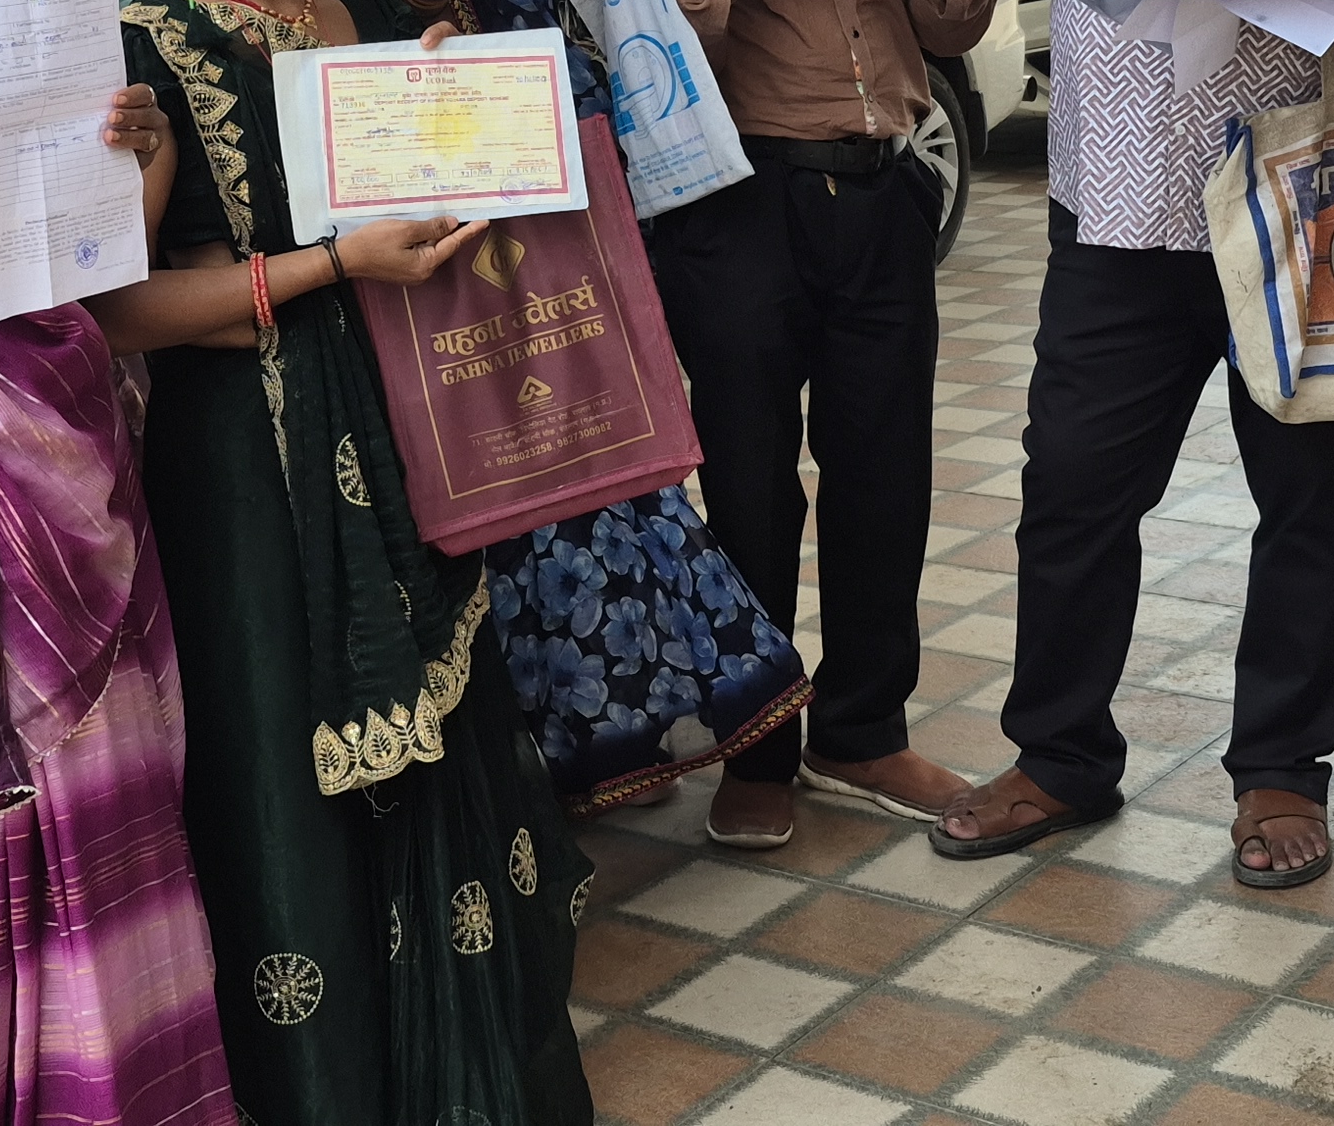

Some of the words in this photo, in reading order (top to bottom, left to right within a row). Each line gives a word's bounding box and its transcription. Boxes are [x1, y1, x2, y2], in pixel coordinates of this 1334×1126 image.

[441, 76, 457, 84] Bank
[430, 314, 507, 356] गहना
[509, 275, 598, 329] ज्वेलर्स
[441, 354, 505, 386] GAHNA
[507, 320, 605, 368] JEWELLERS
